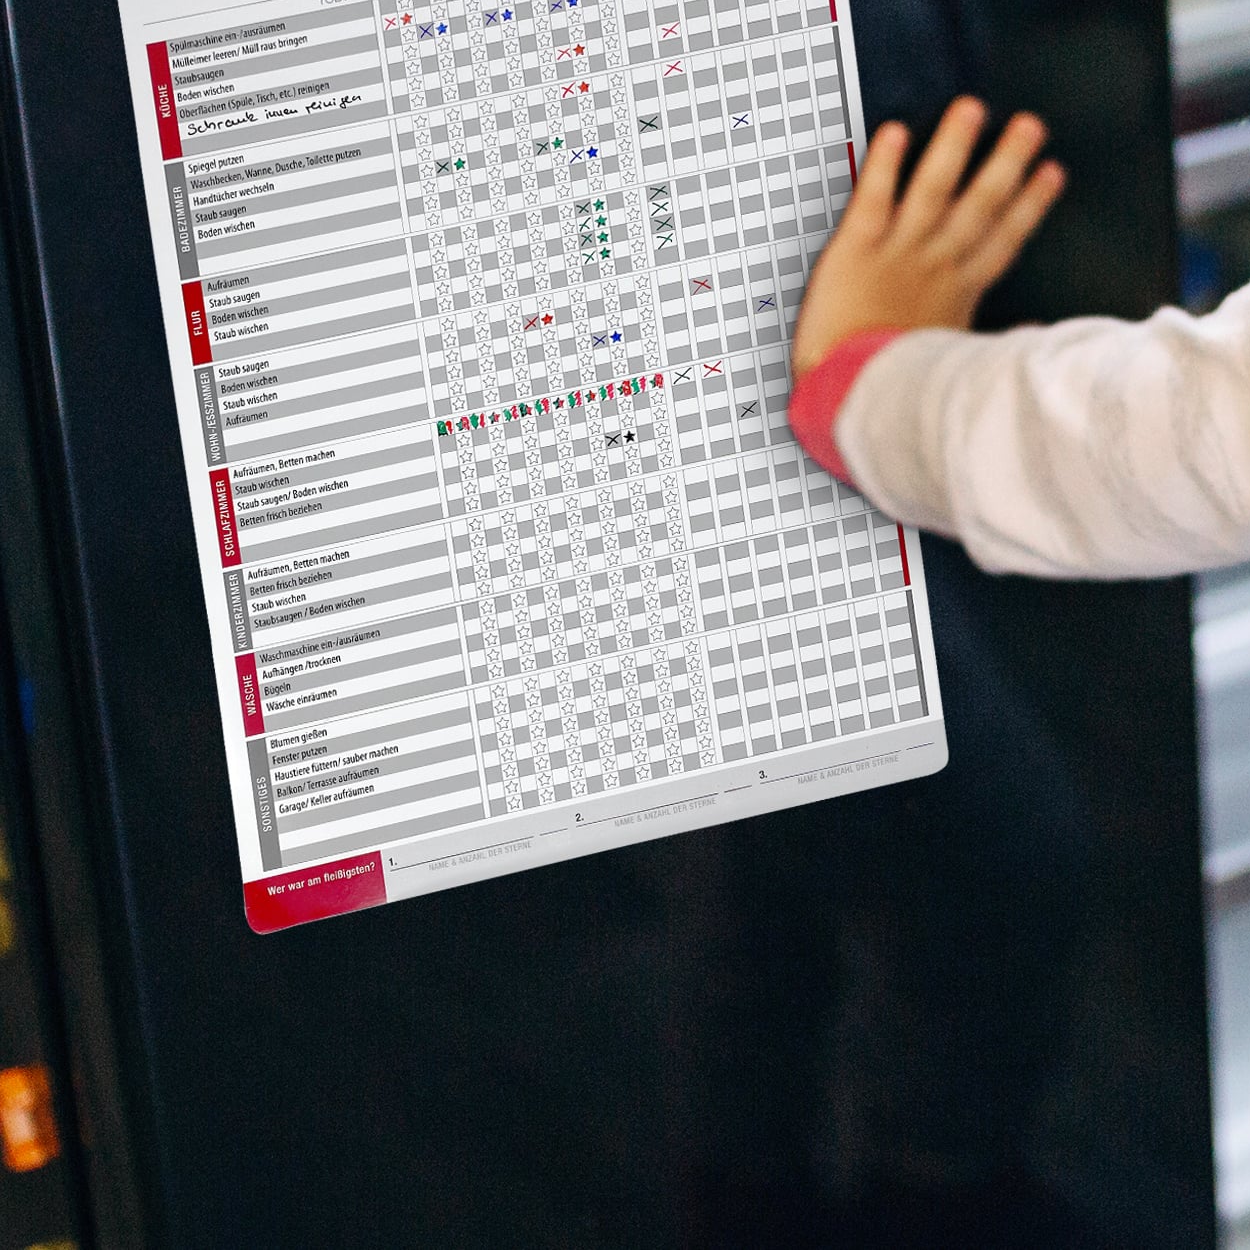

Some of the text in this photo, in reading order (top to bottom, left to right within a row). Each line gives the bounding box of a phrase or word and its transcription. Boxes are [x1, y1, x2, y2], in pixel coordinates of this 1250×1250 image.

[169, 22, 285, 53] Spülmaschine ein-/ausräumen
[171, 35, 307, 68] Mülleimer leeren/ Müll raus bringen
[174, 69, 224, 85] Staubsaugen
[157, 84, 170, 118] KÜCHE
[176, 84, 234, 102] Boden wischen
[178, 82, 330, 118] Oberflächen (Spüle, Tisch, etc.) reinigen
[187, 154, 244, 174] Spiegel putzen
[189, 148, 361, 189] Waschbecken, Wanne, Dusche, Toilette putzen
[192, 181, 274, 206] Handtücher wechseln
[172, 186, 190, 252] BADEZIMMER
[194, 205, 246, 223] Staub saugen
[197, 220, 255, 239] Boden wischen
[207, 276, 249, 291] Aufräumen
[208, 291, 260, 308] Staub saugen
[190, 309, 202, 336] FLUR
[211, 306, 269, 324] Boden wischen
[213, 322, 269, 341] Staub wischen
[217, 360, 269, 378] Staub saugen
[220, 375, 278, 394] Boden wischen
[222, 392, 278, 410] Staub wischen
[199, 372, 220, 461] WOHN-/ESSZIMMER
[225, 411, 268, 426] Aufräumen
[232, 449, 335, 478] Aufräumen, Betten machen
[234, 476, 289, 495] Staub wischen
[236, 480, 348, 511] Staub saugen/ Boden wischen
[215, 480, 234, 556] SCHLAFZIMMER
[239, 502, 322, 527] Betten frisch beziehen
[247, 550, 350, 579] Aufräumen, Betten machen
[249, 571, 332, 596] Betten frisch beziehen
[228, 573, 247, 648] KINDERZIMMER
[251, 593, 306, 612] Staub wischen
[253, 611, 302, 628] Staubsaugen
[308, 603, 334, 615] Boden
[334, 596, 365, 609] wischen
[259, 629, 380, 663] Waschmaschine ein-/ausräumen
[242, 674, 256, 715] WÄSCHE
[263, 682, 291, 696] Bügeln
[265, 688, 337, 711] Wäsche einräumen
[269, 728, 327, 749] Blumen gießen
[271, 745, 327, 764] Fenster putzen
[274, 745, 399, 781] Haustiere füttern/ sauber machen
[276, 766, 379, 797] Balkon/ Terrasse aufräumen
[758, 769, 768, 779] 3.
[797, 772, 817, 784] NAME
[826, 765, 853, 777] ANZAHL
[855, 760, 870, 771] DER
[871, 754, 898, 767] STERNE
[256, 776, 272, 832] SONSTIGES
[278, 784, 374, 813] Garage/ Keller aufräumen
[613, 815, 634, 826] NAME
[643, 808, 671, 820] ANZAHL
[672, 803, 687, 814] DER
[688, 796, 716, 810] STERNE
[574, 812, 584, 822] 2.
[388, 856, 397, 866] 1.
[428, 859, 449, 870] NAME
[458, 852, 486, 863] ANZAHL
[487, 847, 502, 857] DER
[503, 840, 531, 853] STERNE
[266, 861, 375, 895] Wer war am fleißigsten?
